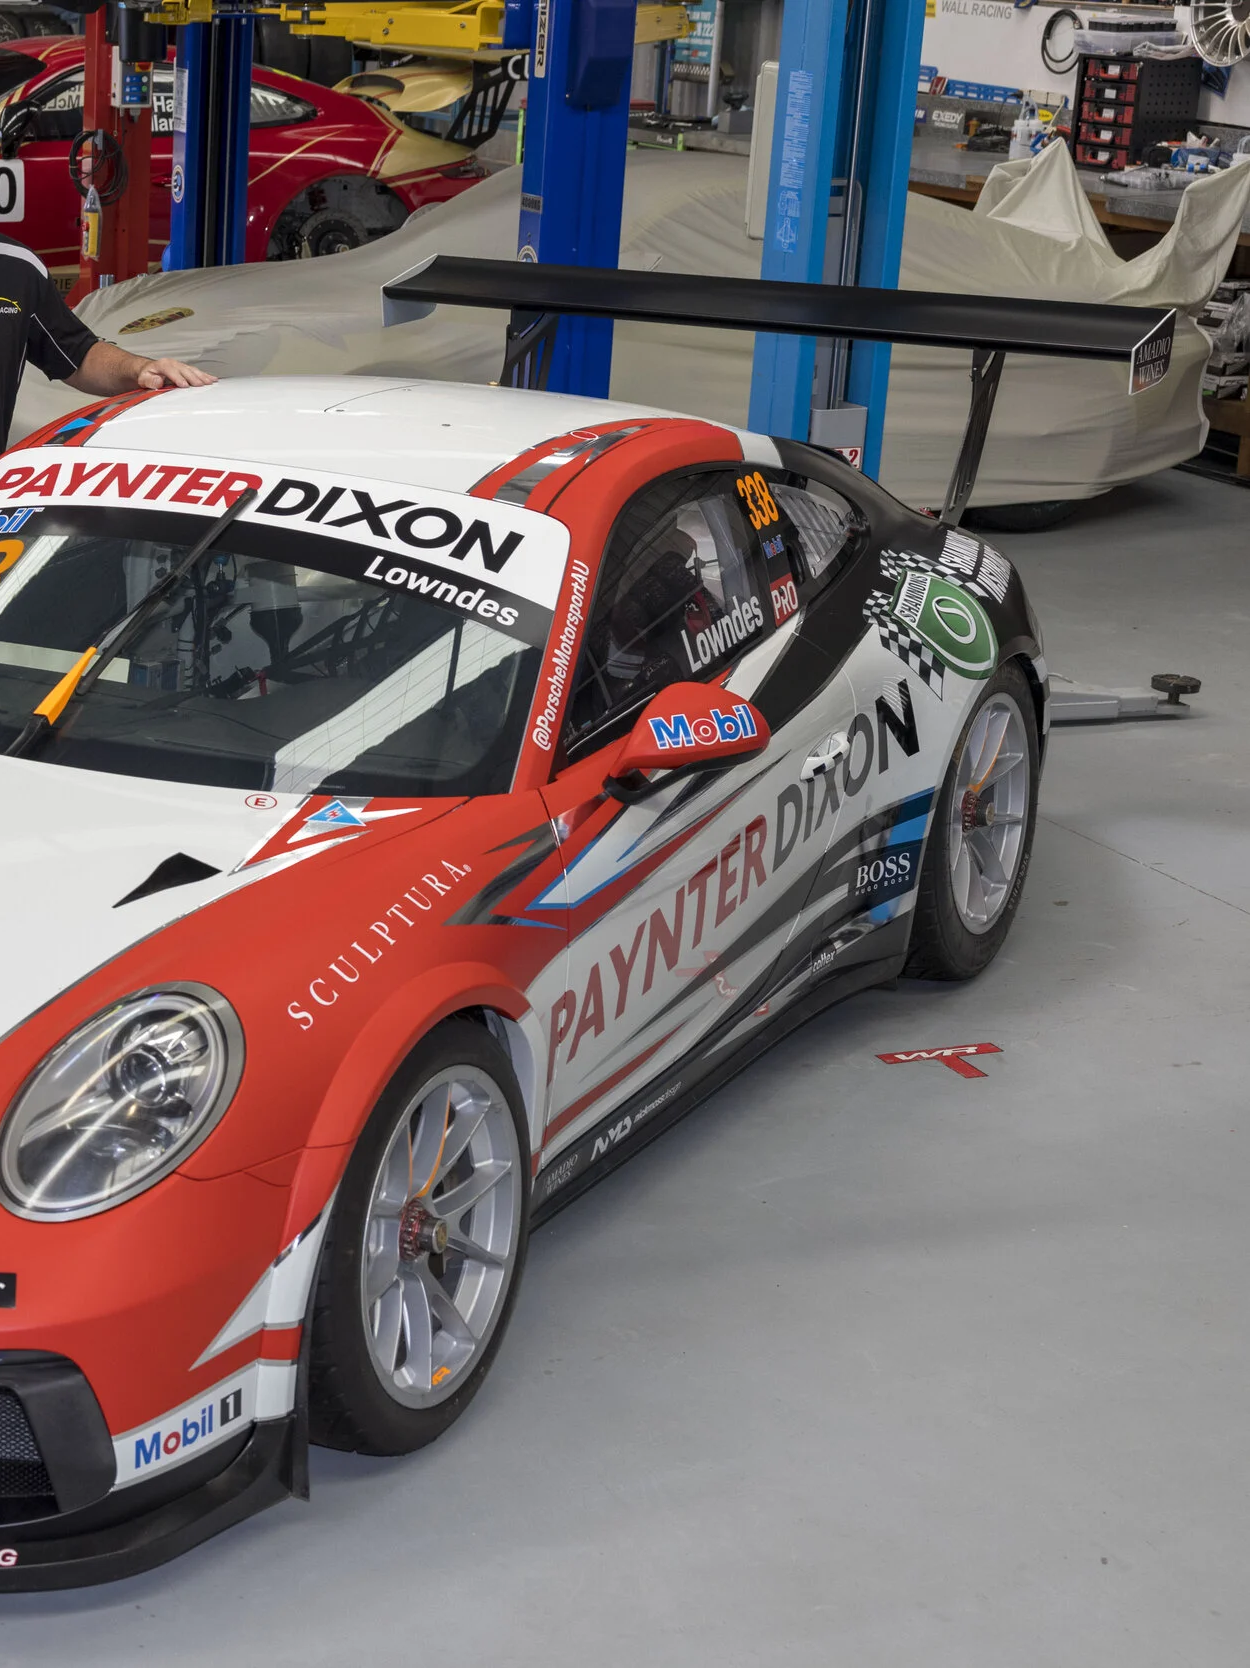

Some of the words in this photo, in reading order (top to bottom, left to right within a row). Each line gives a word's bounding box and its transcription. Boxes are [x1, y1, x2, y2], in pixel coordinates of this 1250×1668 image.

[971, 3, 1012, 19] RACING
[932, 110, 964, 124] EXEDY
[1136, 336, 1171, 364] AMADIO
[1139, 359, 1165, 384] WINES
[736, 471, 779, 530] 338
[762, 534, 784, 560] Mobil
[363, 555, 519, 627] Lowndes
[771, 581, 798, 619] PRO
[900, 573, 929, 624] SHANNONS
[681, 595, 763, 674] Lowndes
[532, 559, 590, 751] @PorscheMotorsportAU
[648, 704, 757, 749] Mobil
[855, 853, 911, 889] BOSS
[855, 884, 878, 896] HUGO
[884, 875, 910, 887] BOSS
[134, 1404, 214, 1469] Mobil
